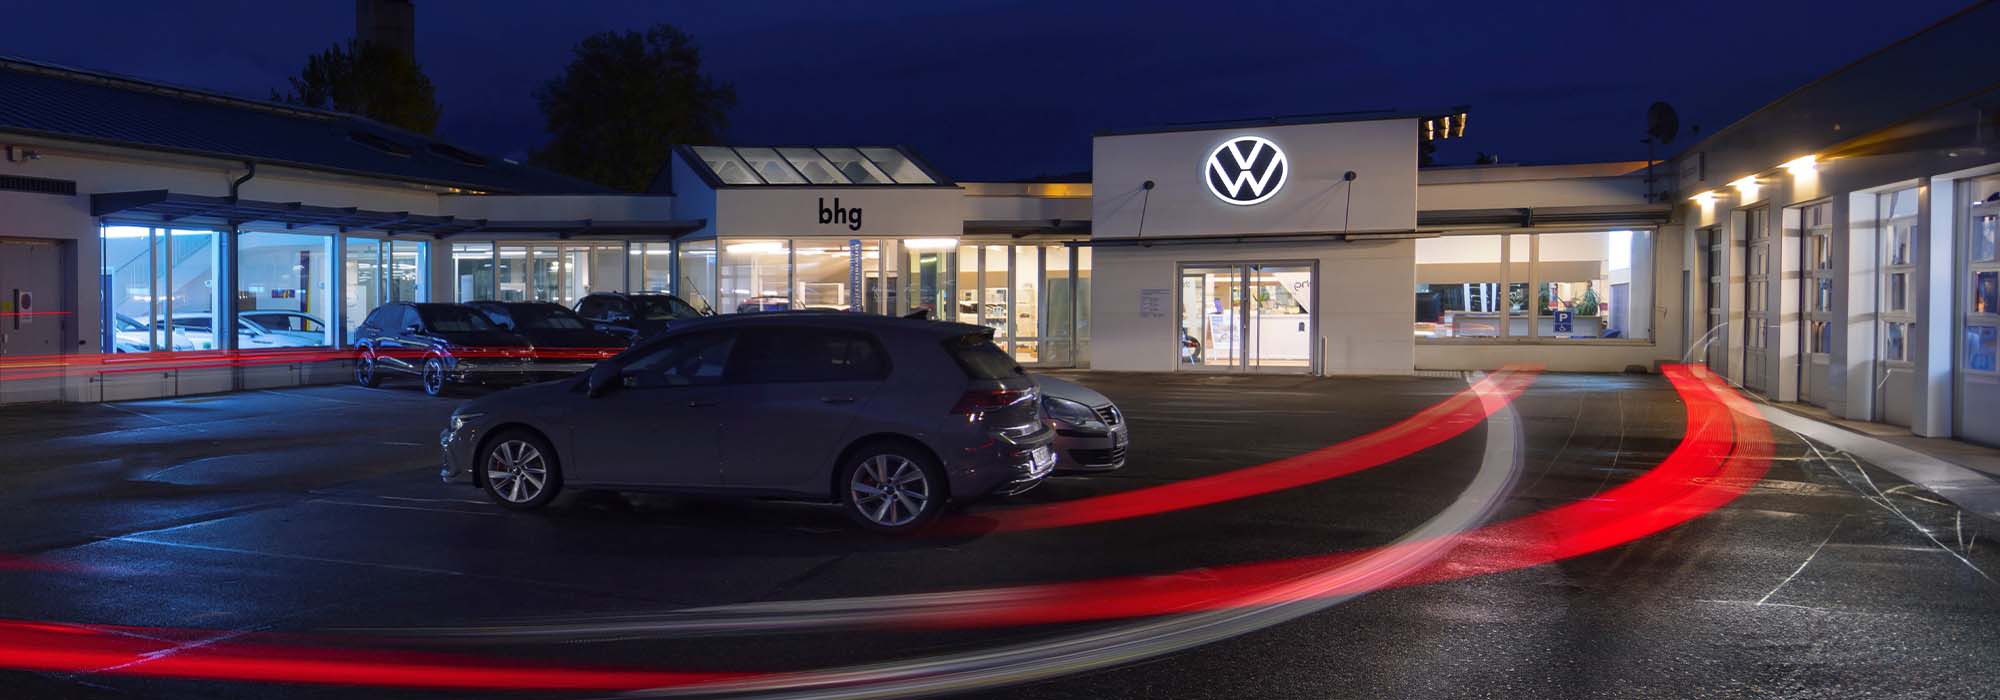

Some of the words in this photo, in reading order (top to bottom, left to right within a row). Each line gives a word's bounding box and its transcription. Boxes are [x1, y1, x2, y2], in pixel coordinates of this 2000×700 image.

[1208, 138, 1286, 202] VW
[818, 197, 862, 231] bhg
[1559, 313, 1568, 322] P
